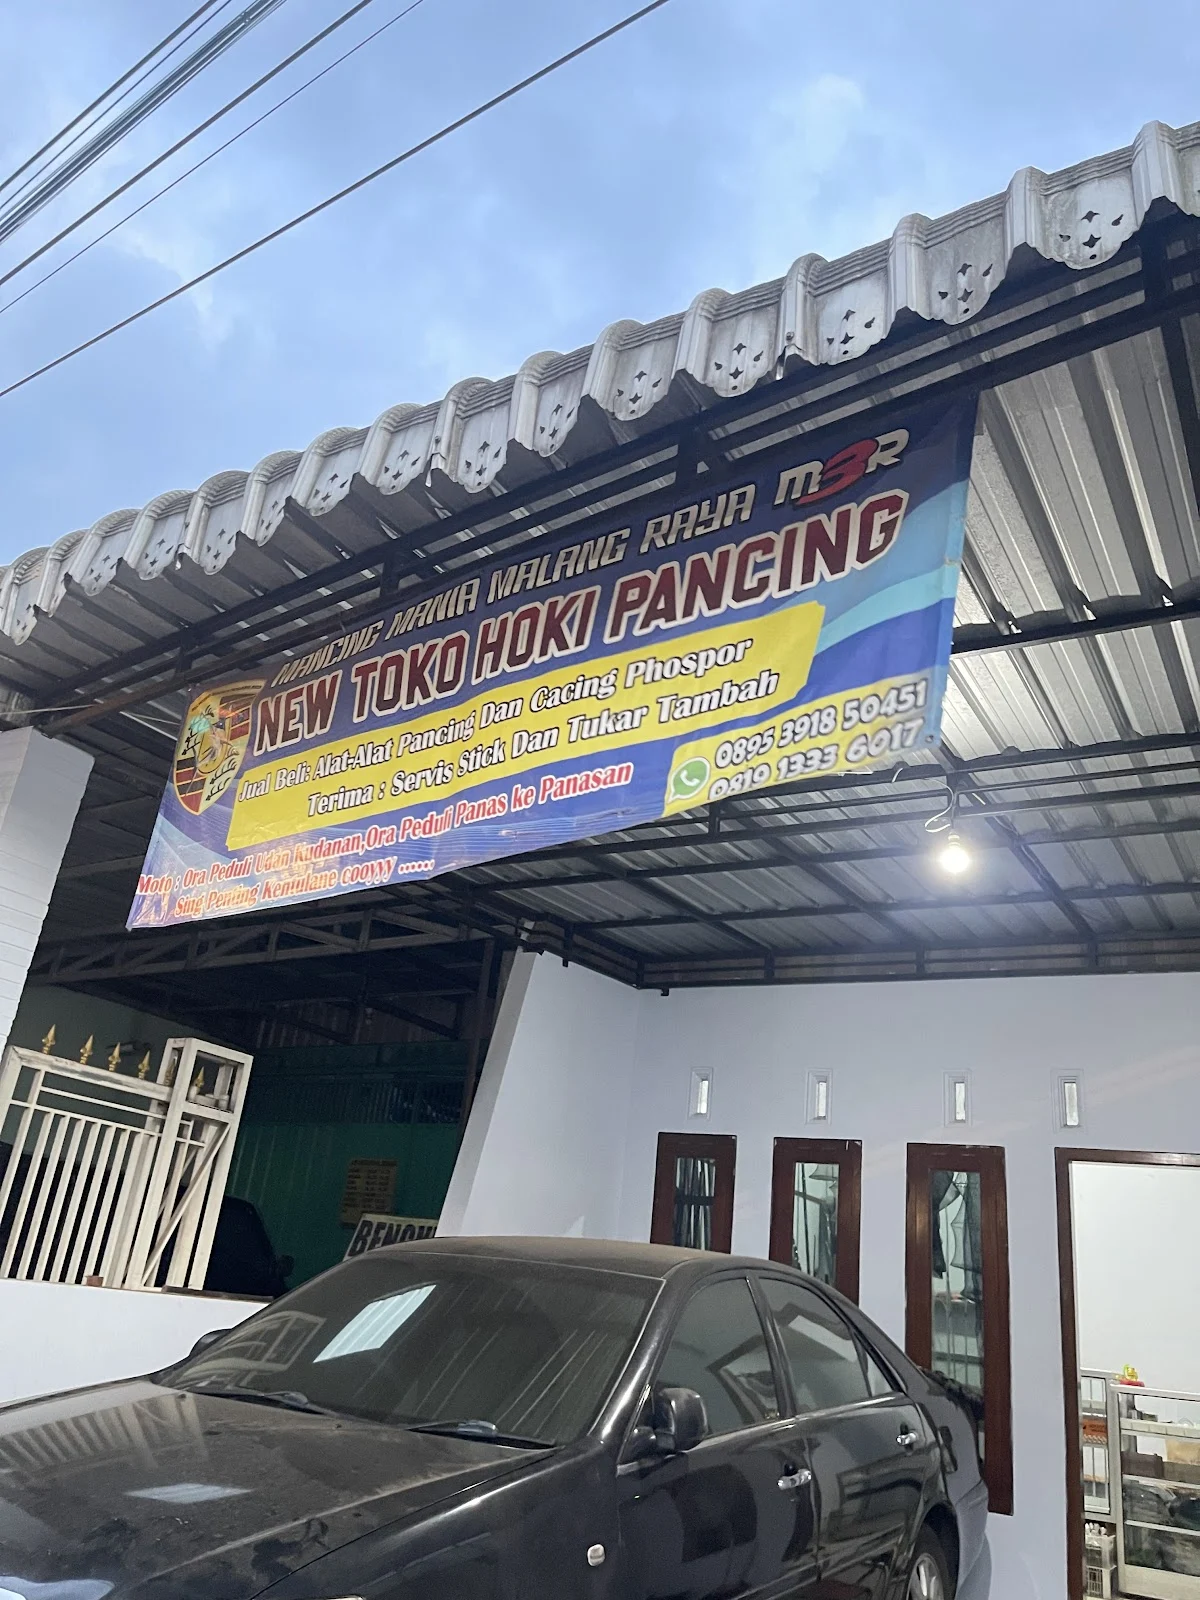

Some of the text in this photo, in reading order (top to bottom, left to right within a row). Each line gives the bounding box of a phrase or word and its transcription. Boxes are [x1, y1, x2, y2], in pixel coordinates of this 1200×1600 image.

[253, 489, 910, 757] NEW TOKO HOKI PANCING
[271, 620, 385, 688] MANCING
[385, 577, 482, 642] MANIA
[487, 527, 632, 604] MALANG
[640, 483, 757, 554] RAYA
[238, 638, 753, 802] Jual Beli: Alat-Alat Pancing Dan Cacing Phospor
[308, 784, 374, 817] Terima
[390, 760, 454, 796] Servis
[457, 737, 506, 777] Stick
[511, 727, 559, 759] Dan
[567, 705, 649, 743] Tukar
[656, 669, 780, 724] Tambah
[714, 678, 928, 769] 0895 3918 50451
[776, 744, 840, 782] 1333
[845, 717, 925, 763] 6017
[137, 876, 173, 895] Moto
[183, 868, 207, 888] Ora
[209, 856, 253, 882] Peduli
[399, 808, 453, 842] Peduli
[454, 793, 508, 827] Panas
[511, 783, 535, 811] ke
[539, 762, 634, 803] Panasan
[174, 896, 202, 918] Sing
